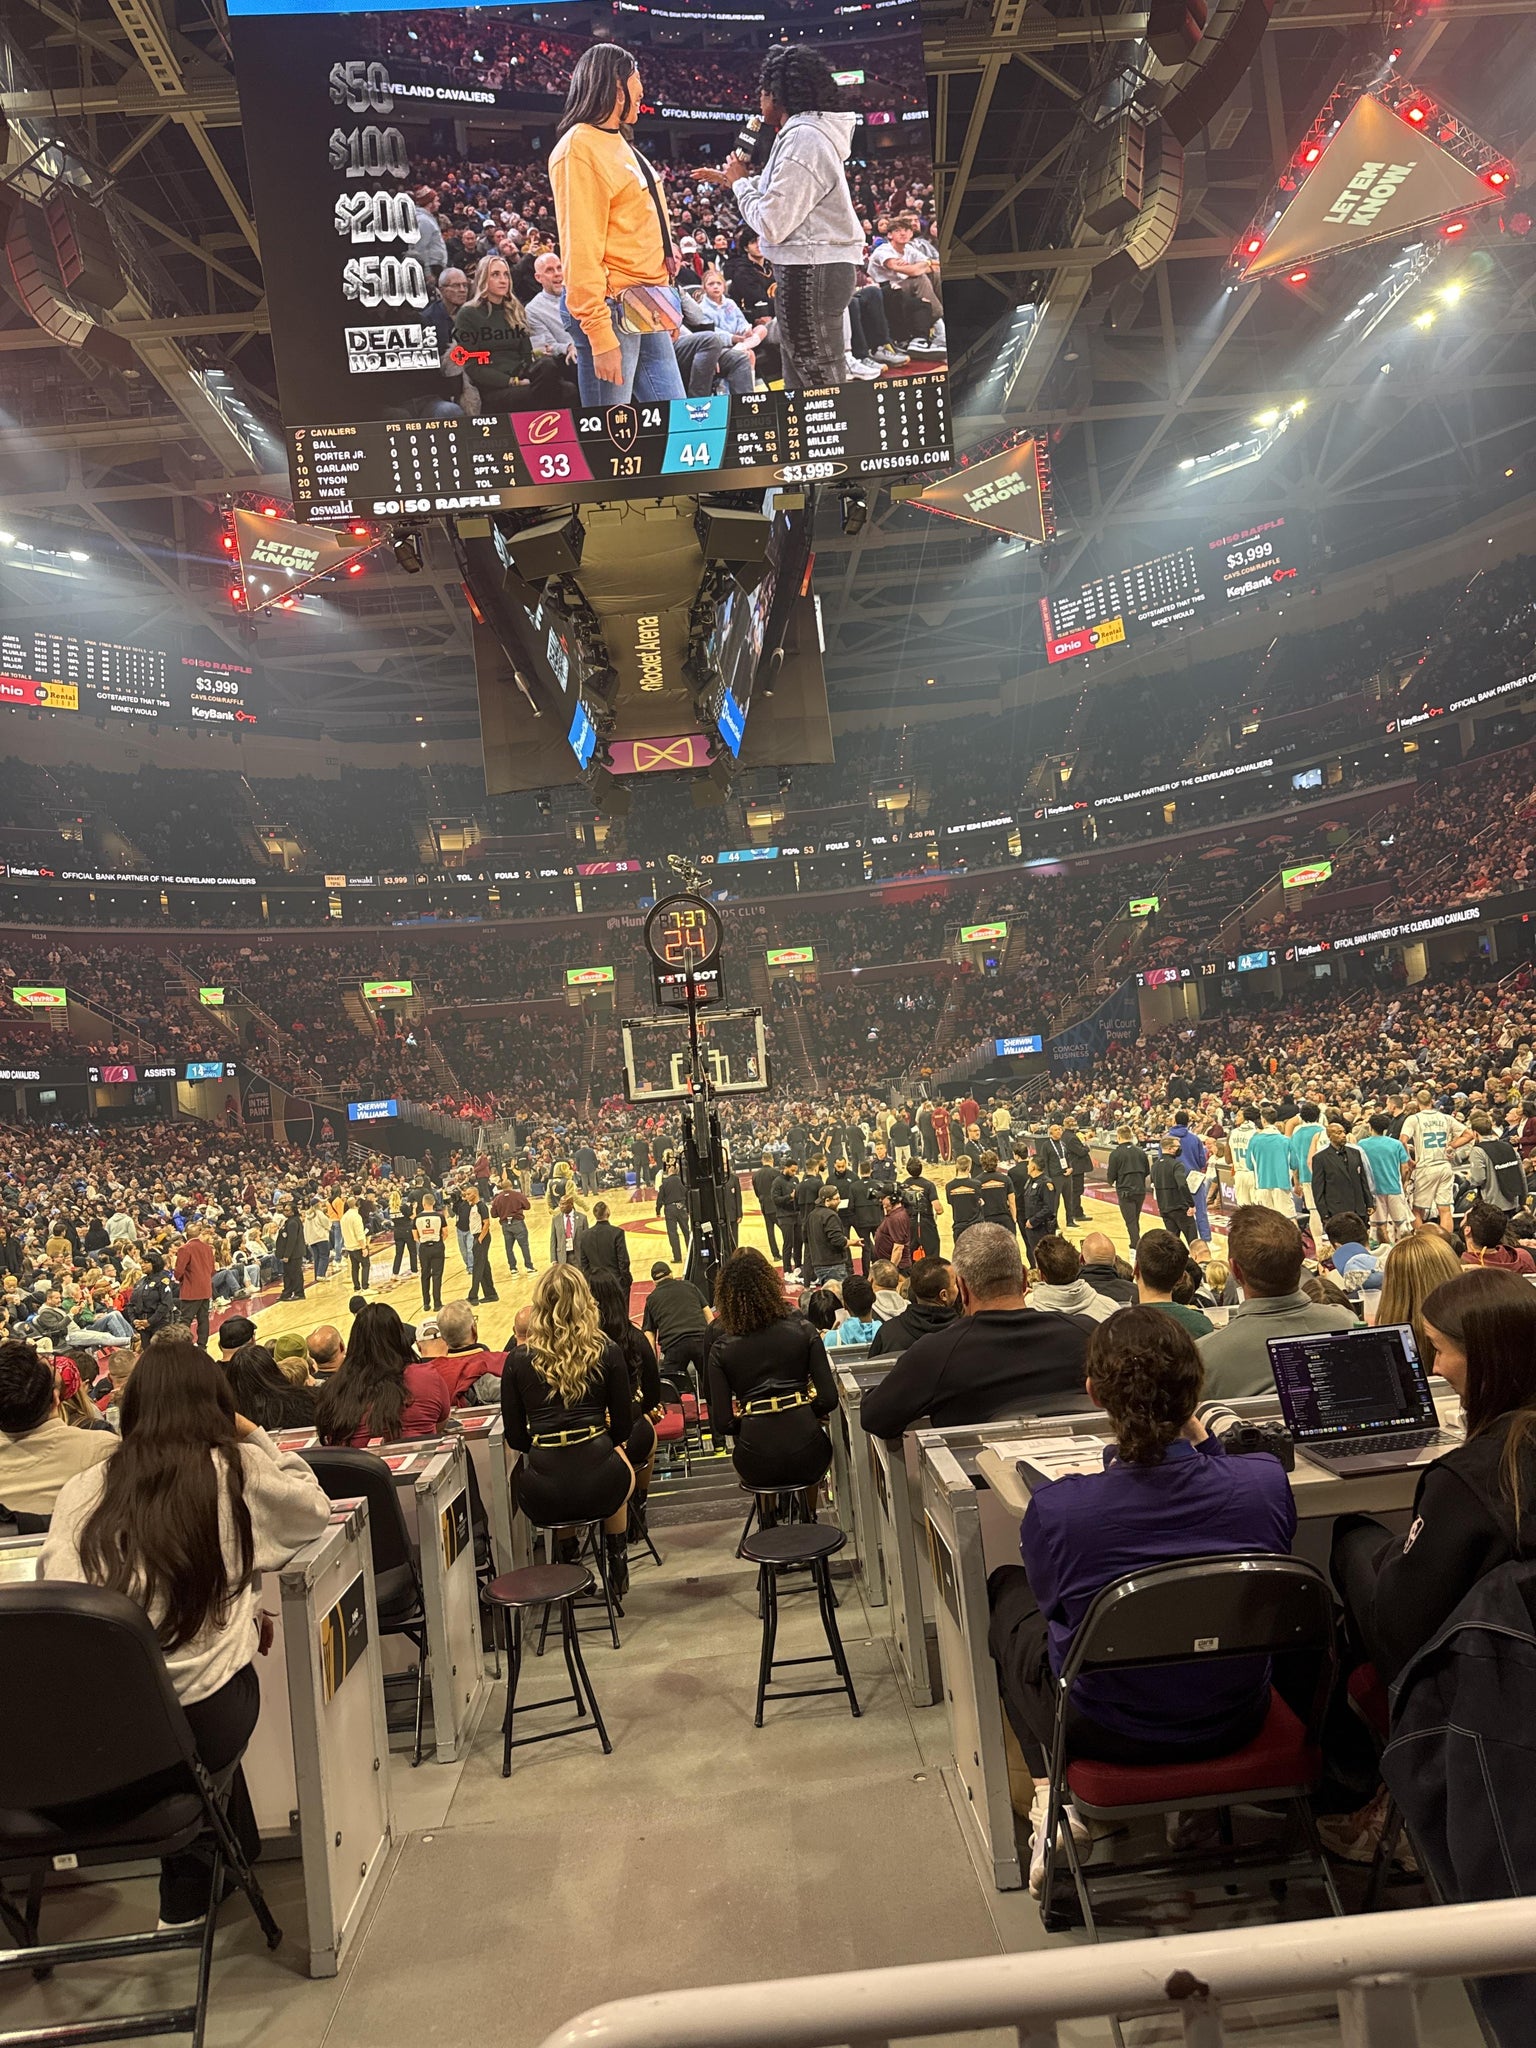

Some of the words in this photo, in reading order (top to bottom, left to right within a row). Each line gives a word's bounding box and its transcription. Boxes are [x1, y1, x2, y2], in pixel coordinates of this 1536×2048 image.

[329, 61, 394, 114] $50
[436, 87, 495, 104] CAVALIERS
[662, 108, 690, 118] OFFICIAL
[329, 125, 410, 178] $100
[1322, 190, 1361, 224] LET
[1347, 161, 1386, 190] EM
[1347, 161, 1418, 226] KNOW.
[334, 191, 421, 244] $200
[342, 256, 429, 309] $500
[349, 327, 419, 351] DEAL
[422, 325, 437, 347] OR
[449, 324, 527, 345] KeyBank
[350, 352, 381, 372] NO
[385, 350, 440, 369] DEAL
[803, 387, 840, 398] HORNETS
[873, 381, 888, 390] PTS
[893, 379, 908, 388] REB
[912, 377, 927, 386] AST
[932, 375, 945, 384] FLS
[742, 394, 766, 403] FOULS
[752, 404, 759, 414] 3
[788, 404, 795, 413] 4
[804, 400, 834, 411] JAMES
[472, 417, 498, 427] FOULS
[580, 418, 601, 432] 2Q
[615, 414, 628, 424] DIFF
[641, 409, 661, 427] 24
[787, 415, 797, 424] 10
[805, 412, 836, 422] GREEN
[311, 426, 356, 437] CAVALIERS
[386, 424, 401, 432] PTS
[406, 422, 422, 431] REB
[426, 421, 440, 430] AST
[444, 420, 458, 428] FLS
[483, 427, 490, 437] 2
[615, 428, 631, 439] -11
[788, 428, 798, 437] 22
[806, 422, 848, 434] PLUMLEE
[737, 433, 749, 442] FG
[764, 431, 776, 440] 53
[789, 439, 800, 448] 24
[807, 435, 839, 446] MILLER
[296, 442, 302, 451] 2
[313, 440, 336, 450] BALL
[738, 445, 754, 454] 3PT
[765, 443, 777, 451] 53
[298, 454, 304, 463] 9
[314, 452, 350, 462] PORTER
[352, 452, 366, 460] JR.
[473, 454, 485, 463] FG
[503, 452, 514, 462] 46
[680, 442, 710, 466] 44
[740, 456, 756, 465] TOL
[772, 454, 778, 463] 6
[790, 451, 800, 460] 31
[808, 446, 844, 458] SALAUN
[539, 453, 570, 478] 33
[610, 456, 642, 475] 7:37
[860, 450, 950, 472] CAVS5050.COM
[296, 466, 308, 476] 10
[316, 463, 359, 474] GARLAND
[474, 466, 490, 475] 3PT
[504, 464, 514, 474] 31
[782, 462, 834, 482] $3,999
[298, 478, 310, 488] 20
[317, 476, 348, 485] TYSON
[476, 480, 492, 489] TOL
[509, 478, 516, 487] 4
[962, 482, 995, 503] LET
[997, 471, 1022, 489] EM
[299, 490, 312, 500] 32
[319, 488, 346, 498] WADE
[969, 480, 1032, 513] KNOW.
[310, 500, 353, 516] oswald
[435, 495, 501, 510] RAFFLE
[1240, 517, 1285, 539] RAFFLE
[256, 539, 288, 554] LET
[290, 546, 320, 560] EM
[1226, 542, 1273, 569] $3,999
[251, 549, 315, 572] KNOW.
[1226, 576, 1273, 598] KeyBank
[1138, 604, 1176, 620] GOTSTARTED
[1176, 599, 1190, 608] THAT
[1152, 616, 1172, 627] MONEY
[1173, 609, 1194, 620] WOULD
[634, 616, 660, 650] Arena
[1055, 641, 1081, 654] Ohio
[213, 661, 253, 674] RAFFLE
[636, 650, 664, 685] Rocket
[196, 677, 238, 695] $3,999
[1401, 712, 1429, 727] KeyBank
[1450, 696, 1477, 712] OFFICIAL
[1478, 688, 1496, 702] BANK
[1497, 676, 1528, 694] PARTNER
[192, 707, 234, 721] KeyBank
[1094, 796, 1122, 807] OFFICIAL
[1124, 791, 1140, 801] BANK
[1141, 783, 1170, 797] PARTNER
[1181, 778, 1194, 786] THE
[1194, 768, 1235, 783] CLEVELAND
[1235, 758, 1274, 774] CAVALIERS
[803, 846, 814, 854] 53
[825, 841, 849, 850] FOULS
[616, 863, 628, 871] 33
[62, 871, 94, 880] OFFICIAL
[96, 873, 116, 881] BANK
[117, 873, 149, 882] PARTNER
[175, 876, 215, 885] CLEVELAND
[217, 877, 256, 885] CAVALIERS
[384, 876, 408, 885] $3,999
[456, 873, 472, 882] TOL
[495, 871, 519, 880] FOULS
[563, 867, 574, 876] 46
[670, 910, 706, 928] 7:37
[1299, 944, 1321, 956] KeyBank
[1334, 938, 1354, 949] OFFICIAL
[1354, 935, 1368, 946] BANK
[1368, 930, 1390, 942] PARTNER
[1400, 926, 1410, 935] THE
[1410, 916, 1444, 932] CLEVELAND
[1444, 908, 1480, 925] CAVALIERS
[664, 928, 706, 961] 24
[675, 970, 718, 983] TISOT
[1164, 971, 1176, 980] 33
[1201, 964, 1216, 975] 7:37
[1099, 1020, 1113, 1029] Full
[1115, 1018, 1137, 1028] Court
[1106, 1030, 1132, 1040] Power
[1004, 1038, 1032, 1047] SHERWIN
[1052, 1044, 1089, 1052] COMCAST
[1054, 1050, 1090, 1060] BUSINESS
[10, 1070, 40, 1080] CAVALIERS
[144, 1068, 176, 1078] ASSISTS
[256, 1097, 270, 1107] THE
[357, 1102, 388, 1111] SHERWIN
[250, 1106, 270, 1117] PAINT
[1423, 1132, 1447, 1148] 22
[1234, 1148, 1248, 1162] 14
[426, 1218, 430, 1228] 3
